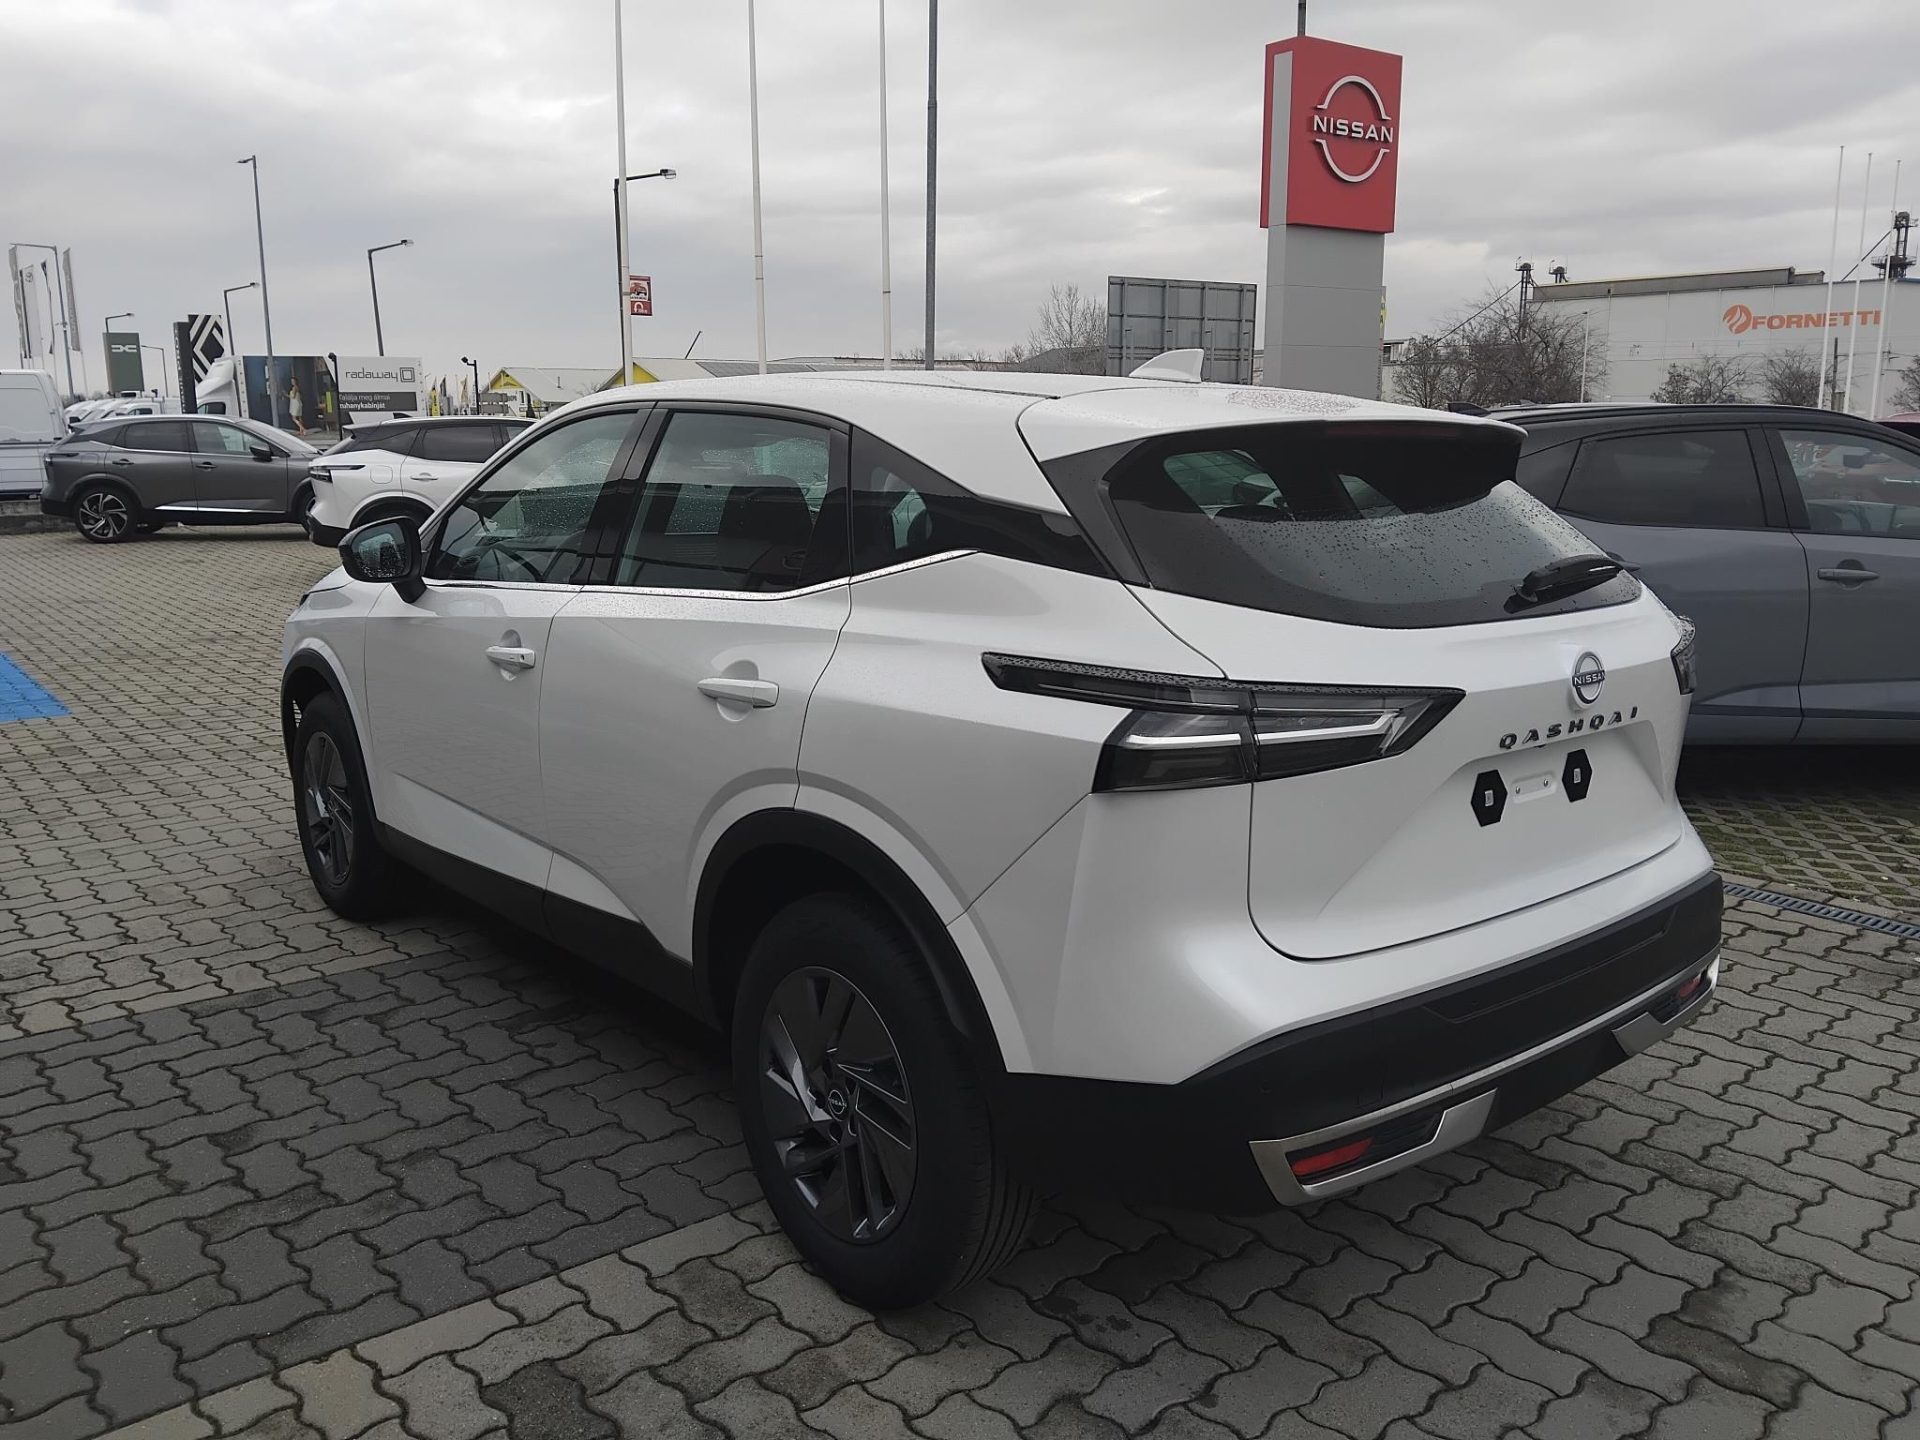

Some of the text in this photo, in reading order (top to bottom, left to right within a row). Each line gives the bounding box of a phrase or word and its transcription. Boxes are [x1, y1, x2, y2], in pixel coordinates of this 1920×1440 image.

[1313, 115, 1393, 142] NISSAN
[1751, 310, 1882, 330] FORNETTI
[345, 367, 398, 382] radaway
[1574, 672, 1605, 685] NISSAN
[1499, 706, 1638, 750] QASHQAI
